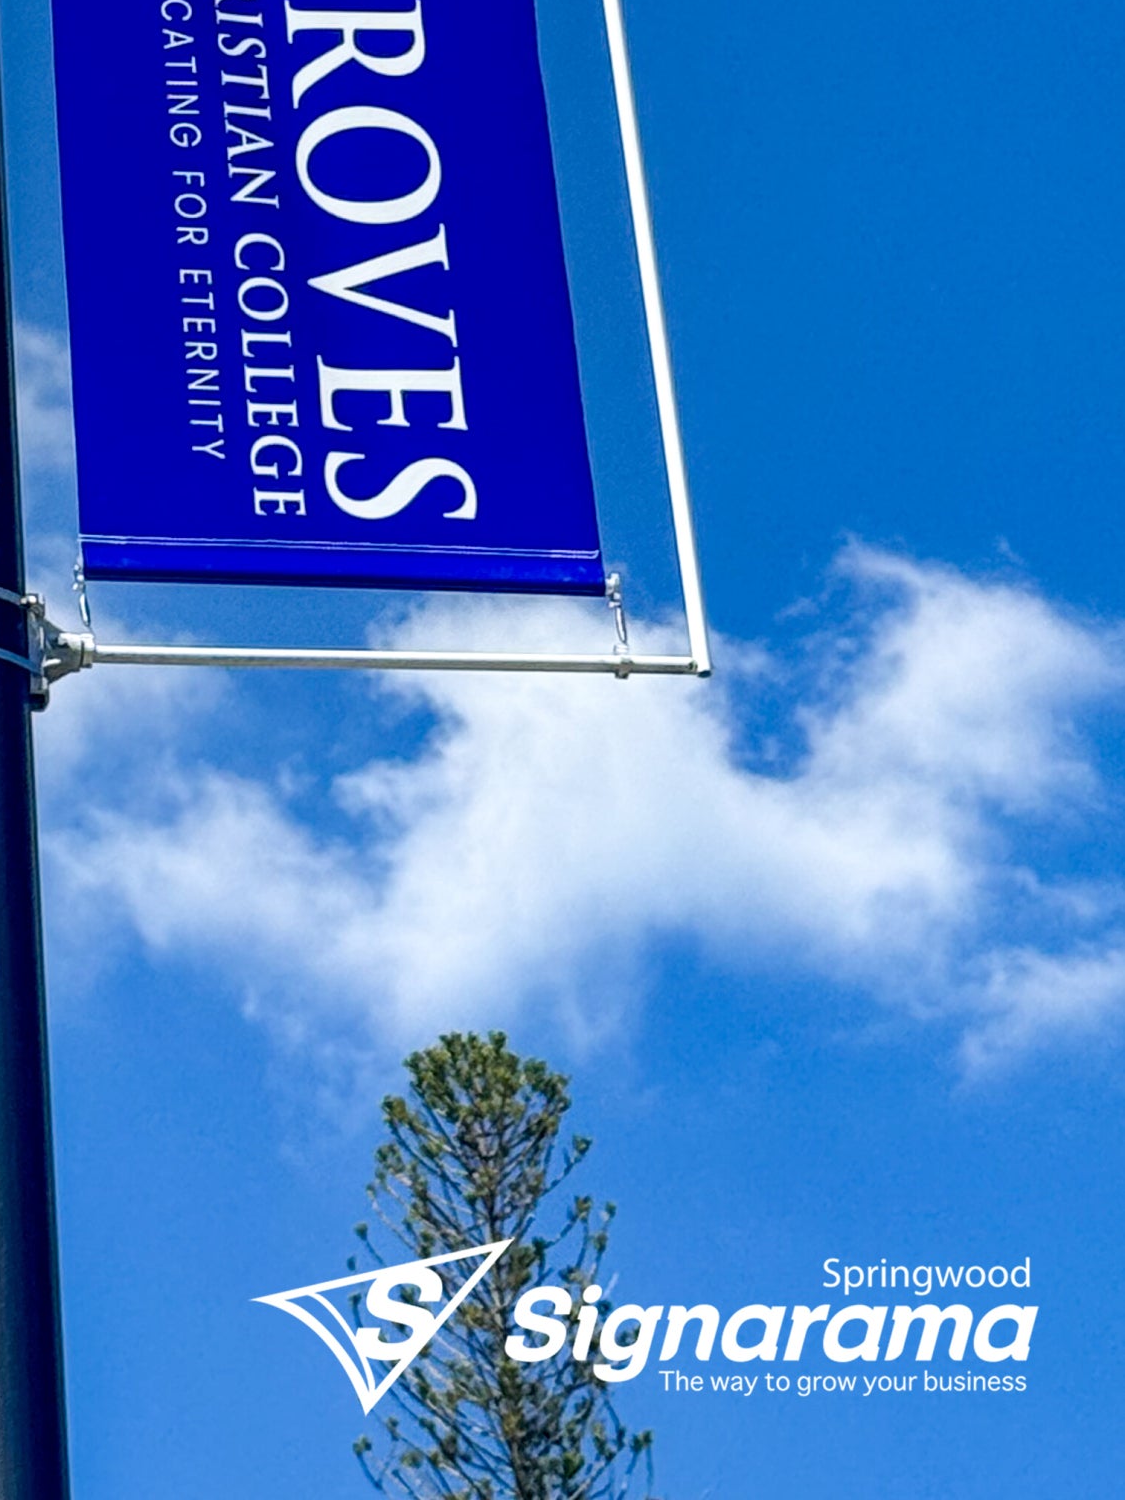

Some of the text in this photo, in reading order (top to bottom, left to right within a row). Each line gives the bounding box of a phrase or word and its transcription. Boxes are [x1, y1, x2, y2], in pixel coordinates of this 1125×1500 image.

[172, 171, 209, 245] FOR
[179, 269, 226, 459] ETERNITY
[234, 233, 306, 516] COLLEGE
